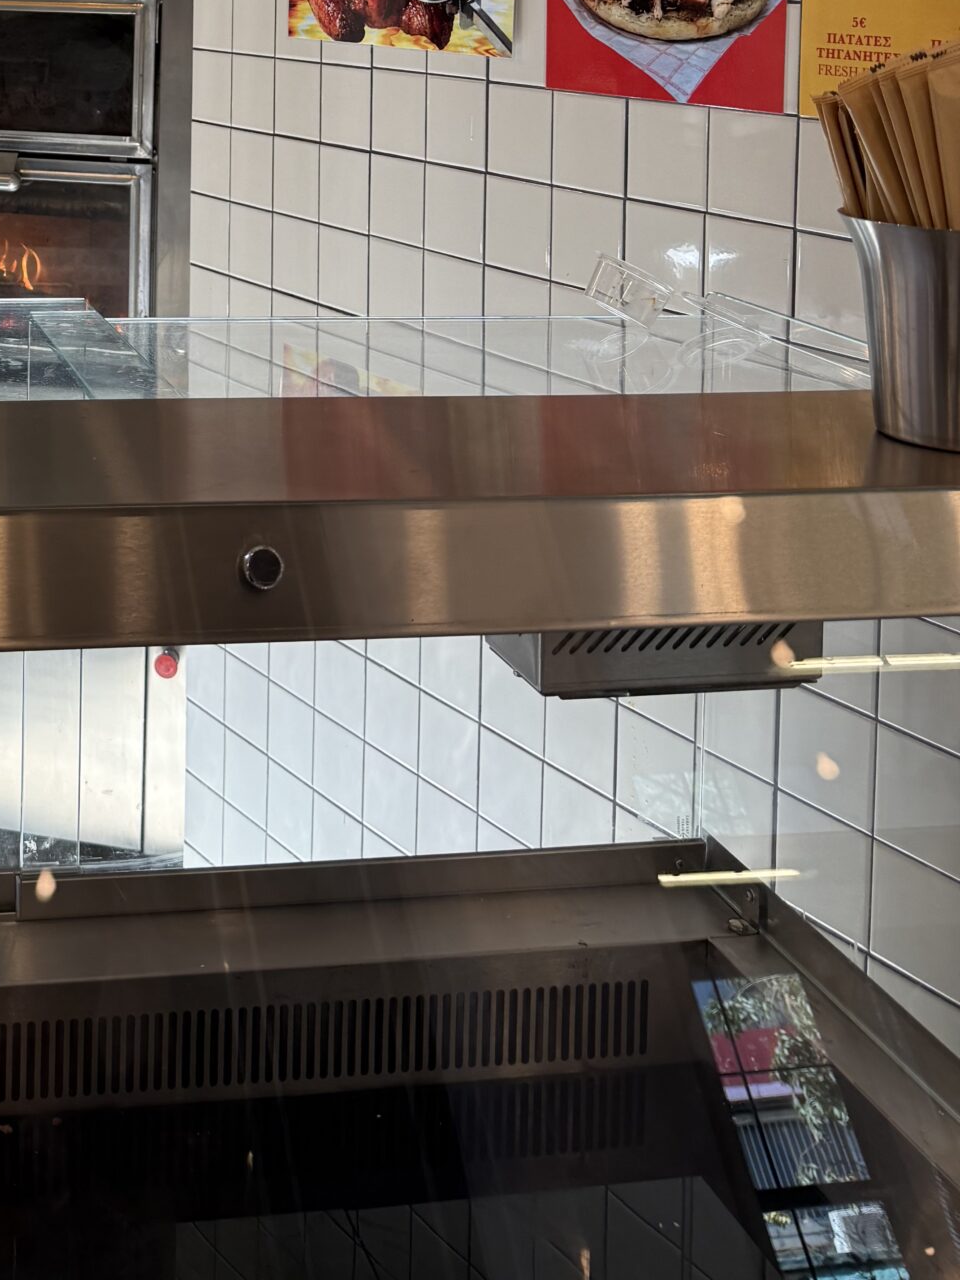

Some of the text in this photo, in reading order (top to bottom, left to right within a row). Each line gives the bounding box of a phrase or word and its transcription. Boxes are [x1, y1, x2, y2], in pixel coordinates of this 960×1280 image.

[852, 17, 866, 28] 5€
[827, 32, 892, 47] ΠΑΤΑΤΕΣ
[818, 63, 858, 77] FRESH
